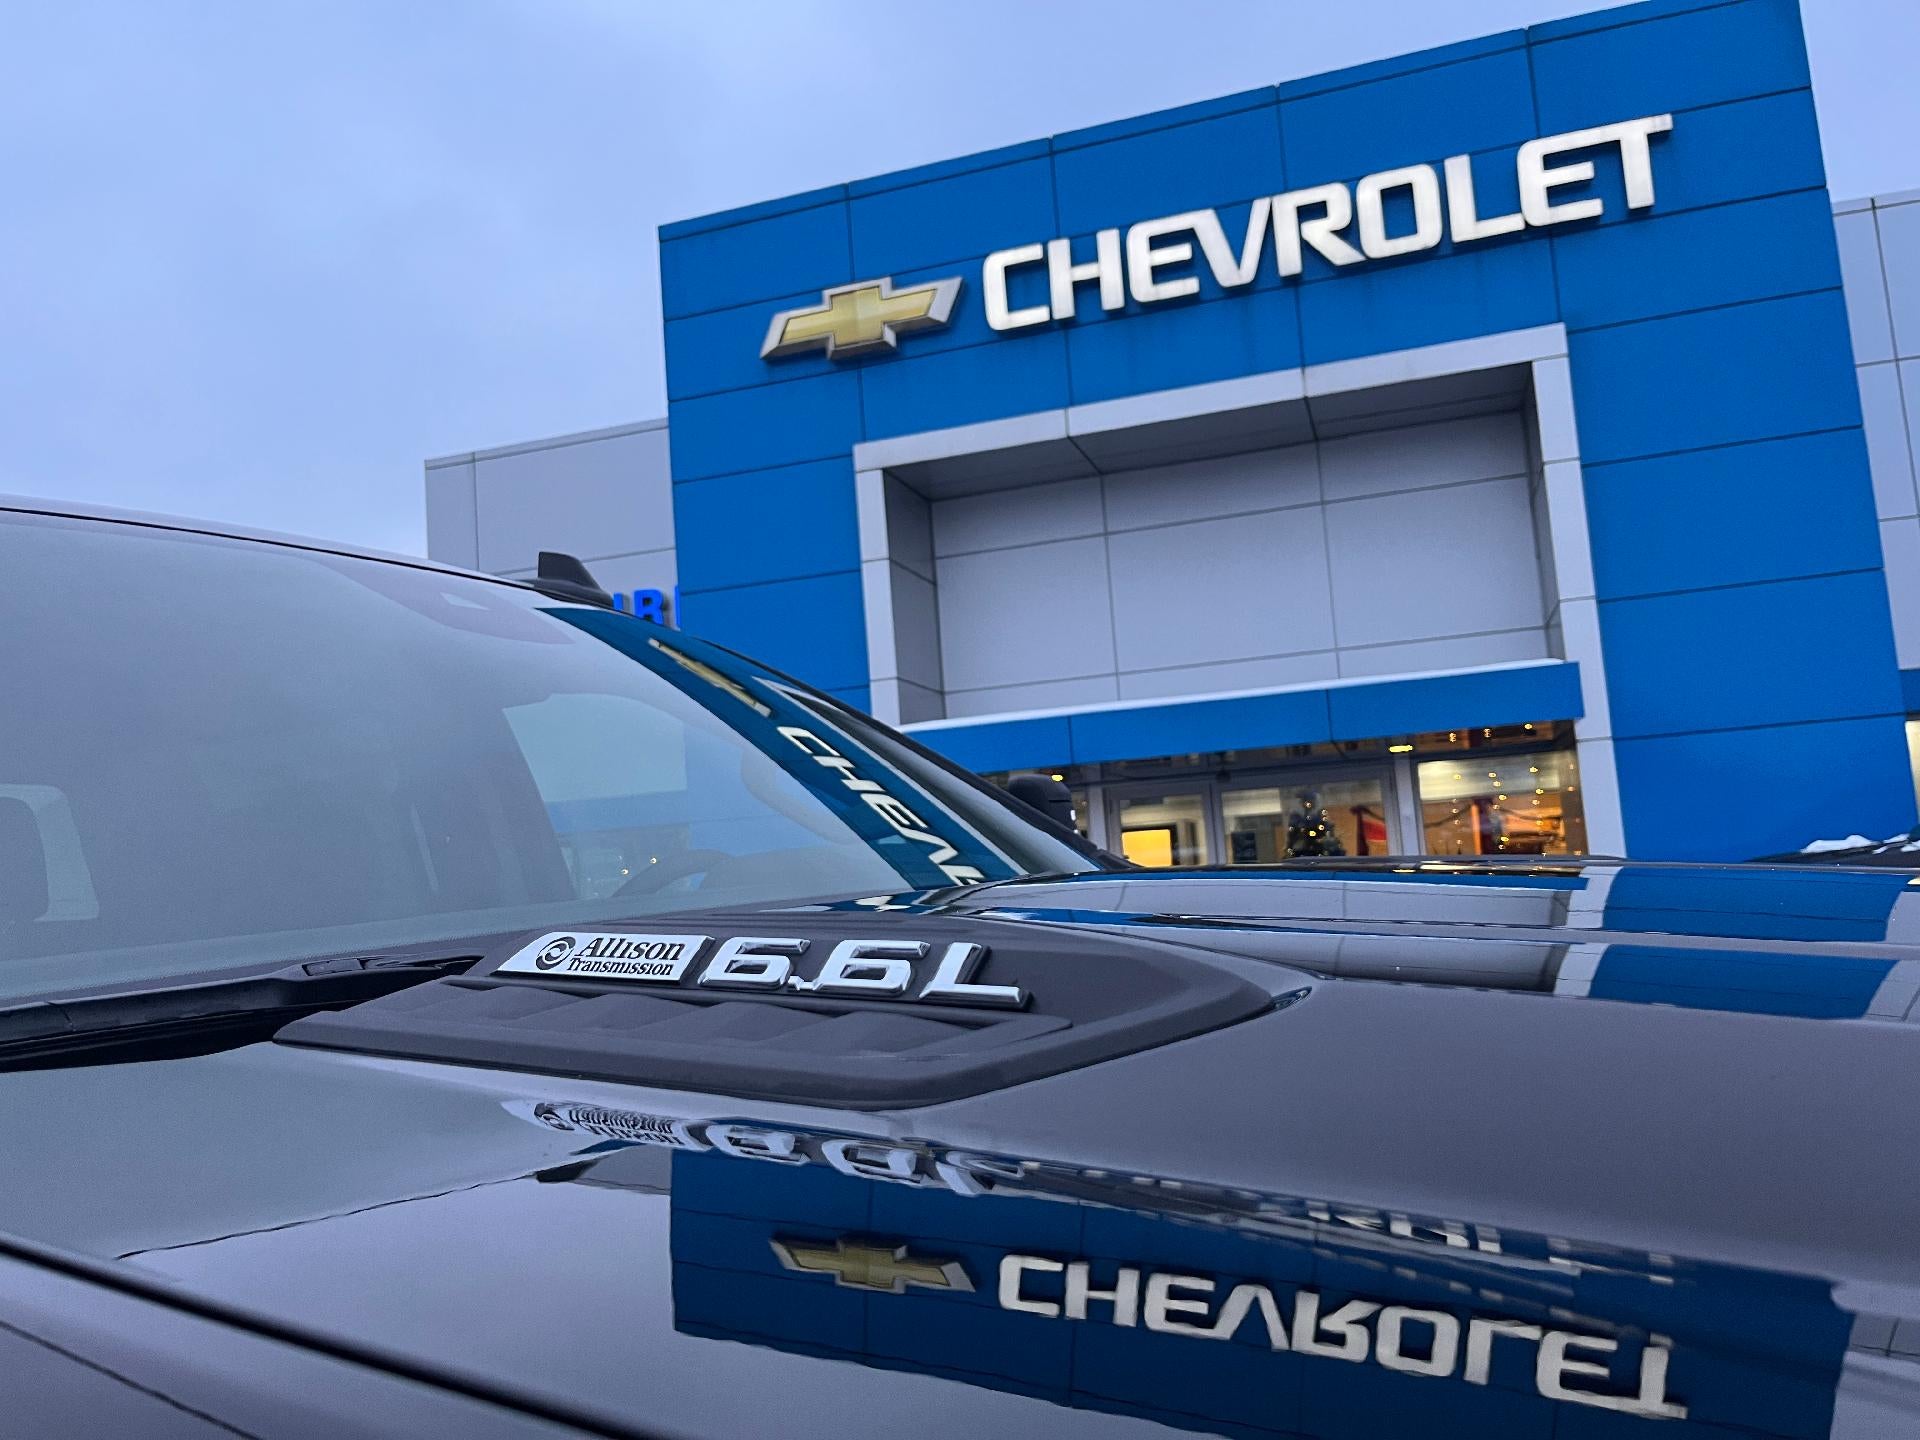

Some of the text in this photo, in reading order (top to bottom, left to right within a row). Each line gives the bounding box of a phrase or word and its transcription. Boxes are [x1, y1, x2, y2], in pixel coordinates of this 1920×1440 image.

[982, 113, 1673, 331] CHEVROLET
[566, 957, 674, 976] Transmission
[574, 937, 686, 961] Allison
[697, 936, 1029, 1009] 6.6L
